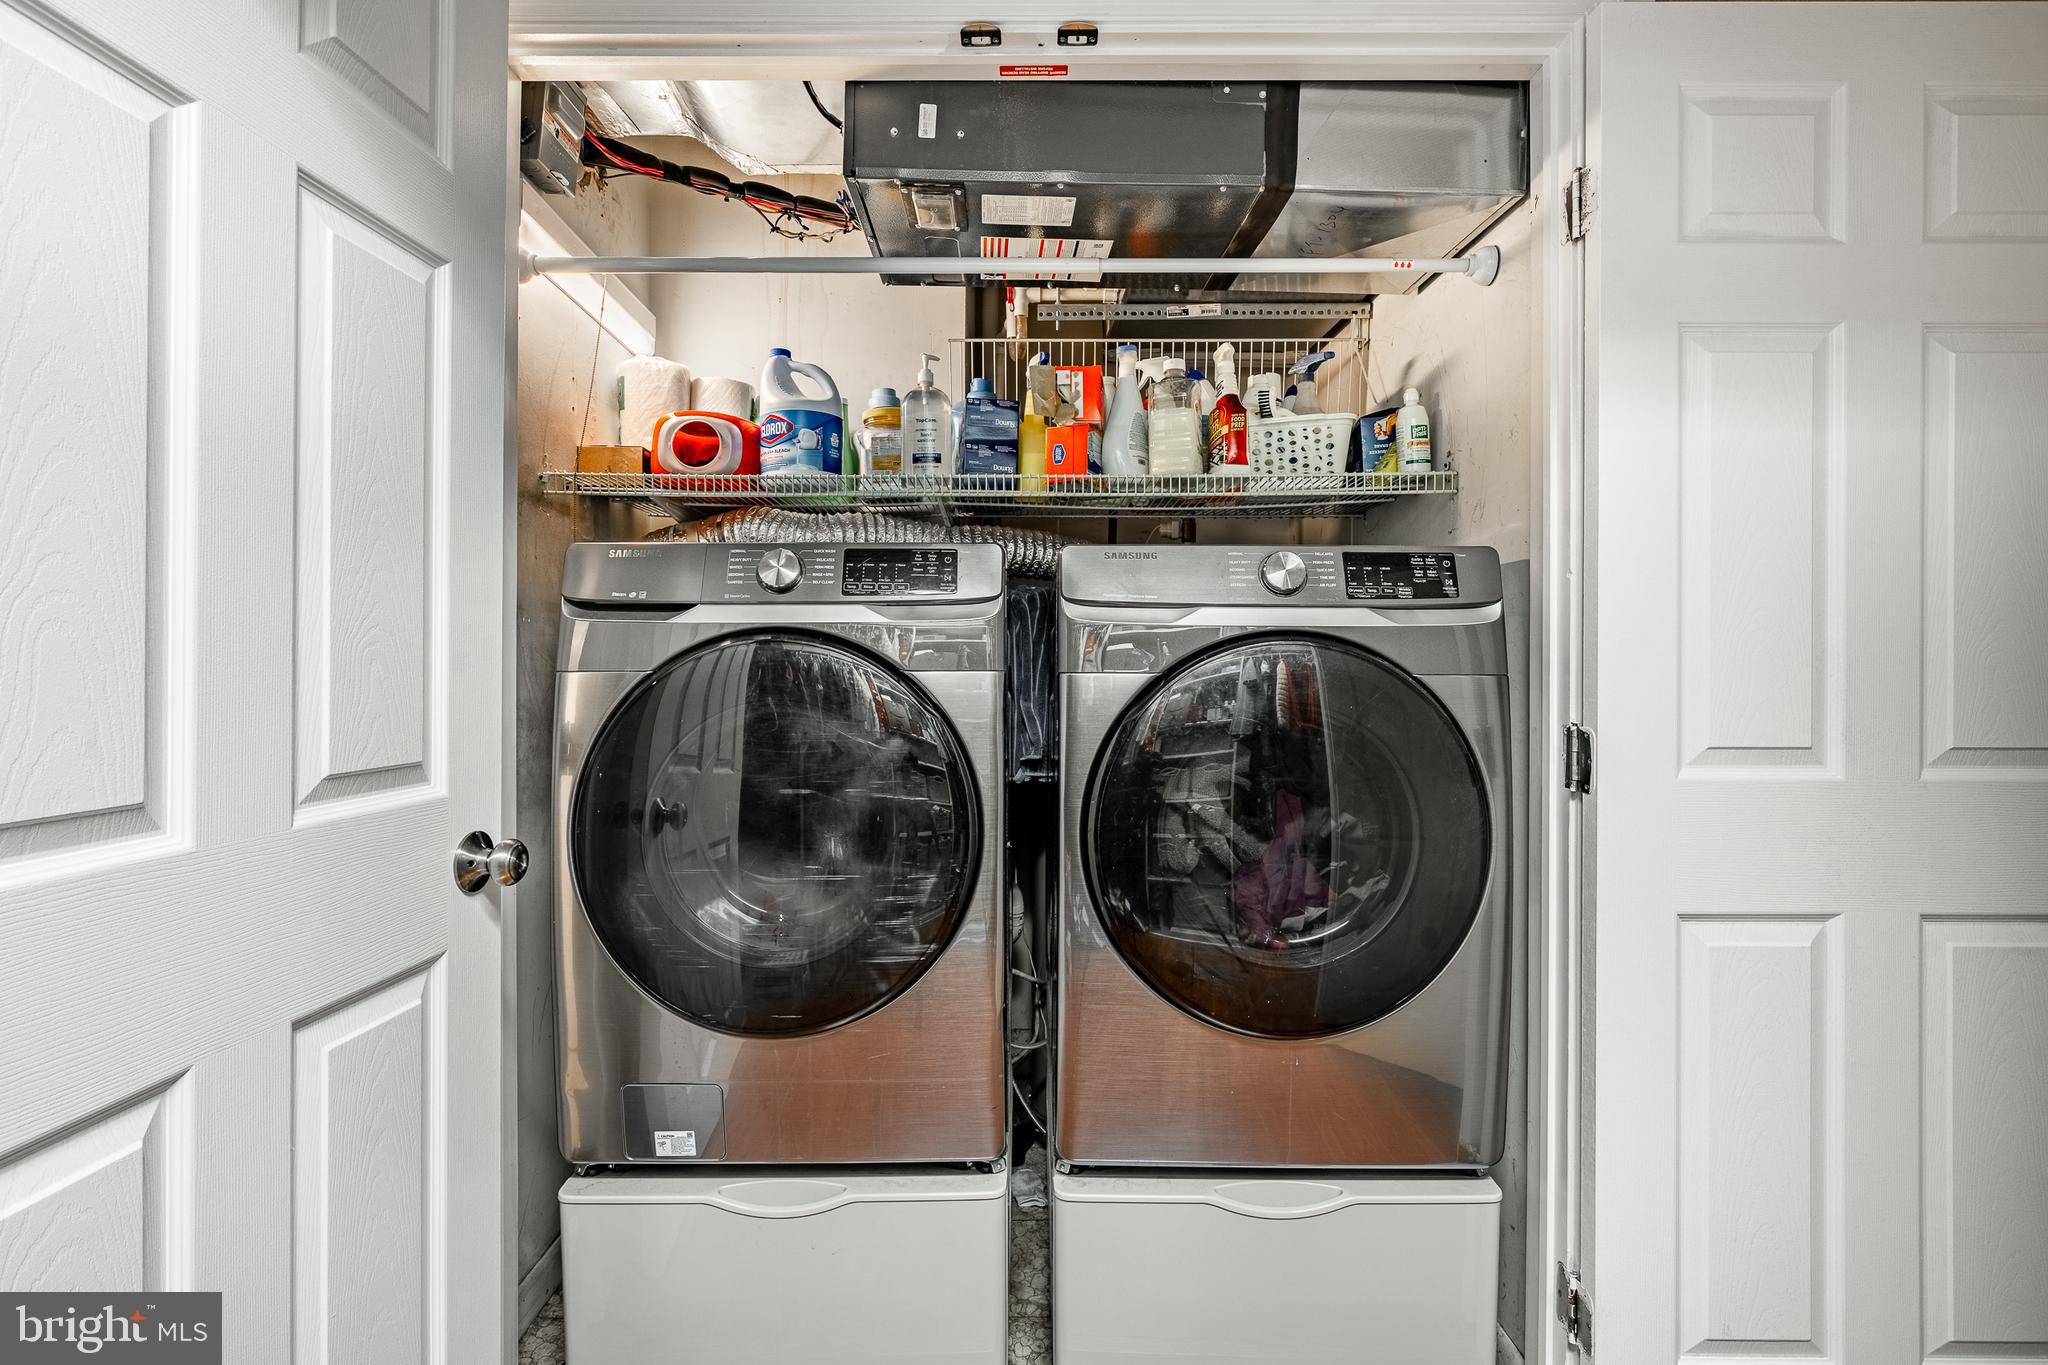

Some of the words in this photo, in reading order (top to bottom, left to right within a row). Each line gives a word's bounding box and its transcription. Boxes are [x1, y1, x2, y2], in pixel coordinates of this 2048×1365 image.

[995, 418, 1016, 428] Downy
[774, 447, 791, 455] BLEACH
[993, 464, 1014, 473] Downy
[1104, 551, 1158, 560] SAMSUNG
